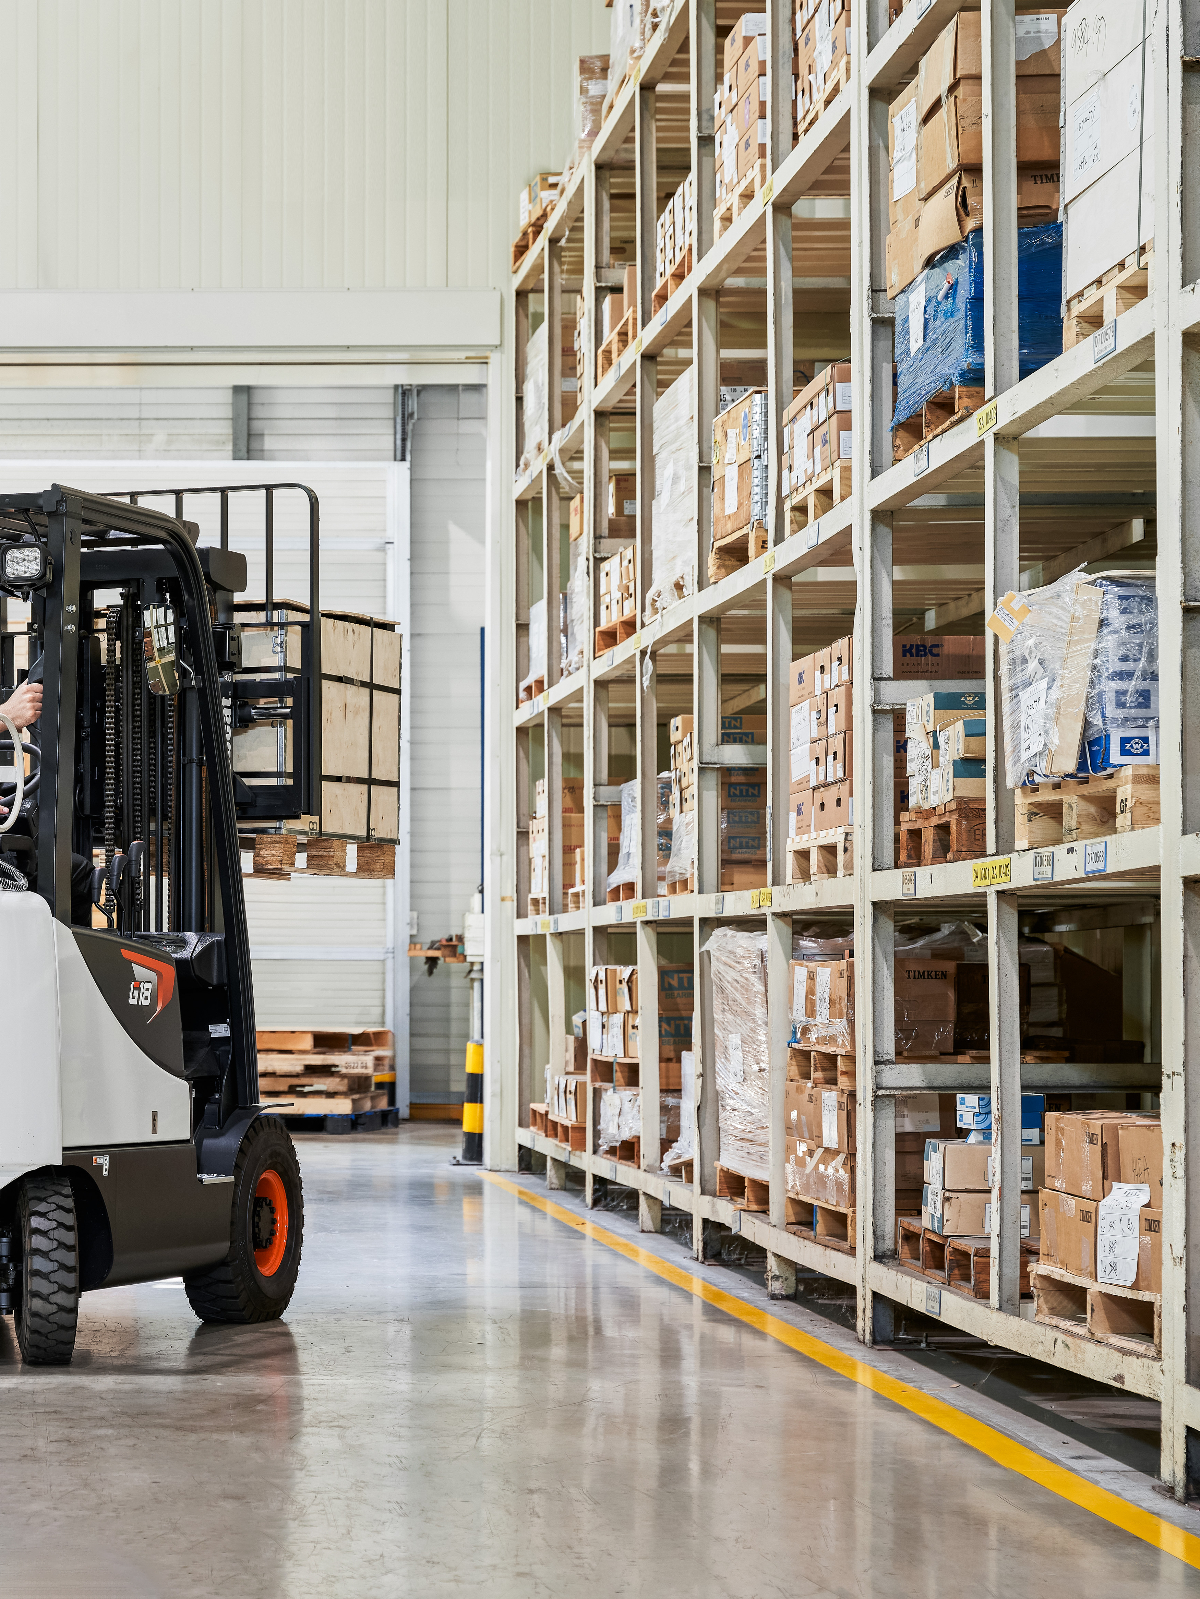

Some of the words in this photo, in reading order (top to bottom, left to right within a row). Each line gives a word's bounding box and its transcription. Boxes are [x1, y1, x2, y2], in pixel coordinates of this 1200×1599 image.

[902, 644, 940, 658] KBC
[722, 734, 753, 743] NTN
[730, 786, 758, 796] NTN
[730, 838, 758, 848] NTN
[906, 970, 948, 980] TIMKEN
[664, 974, 694, 988] NT
[129, 981, 152, 1006] G18
